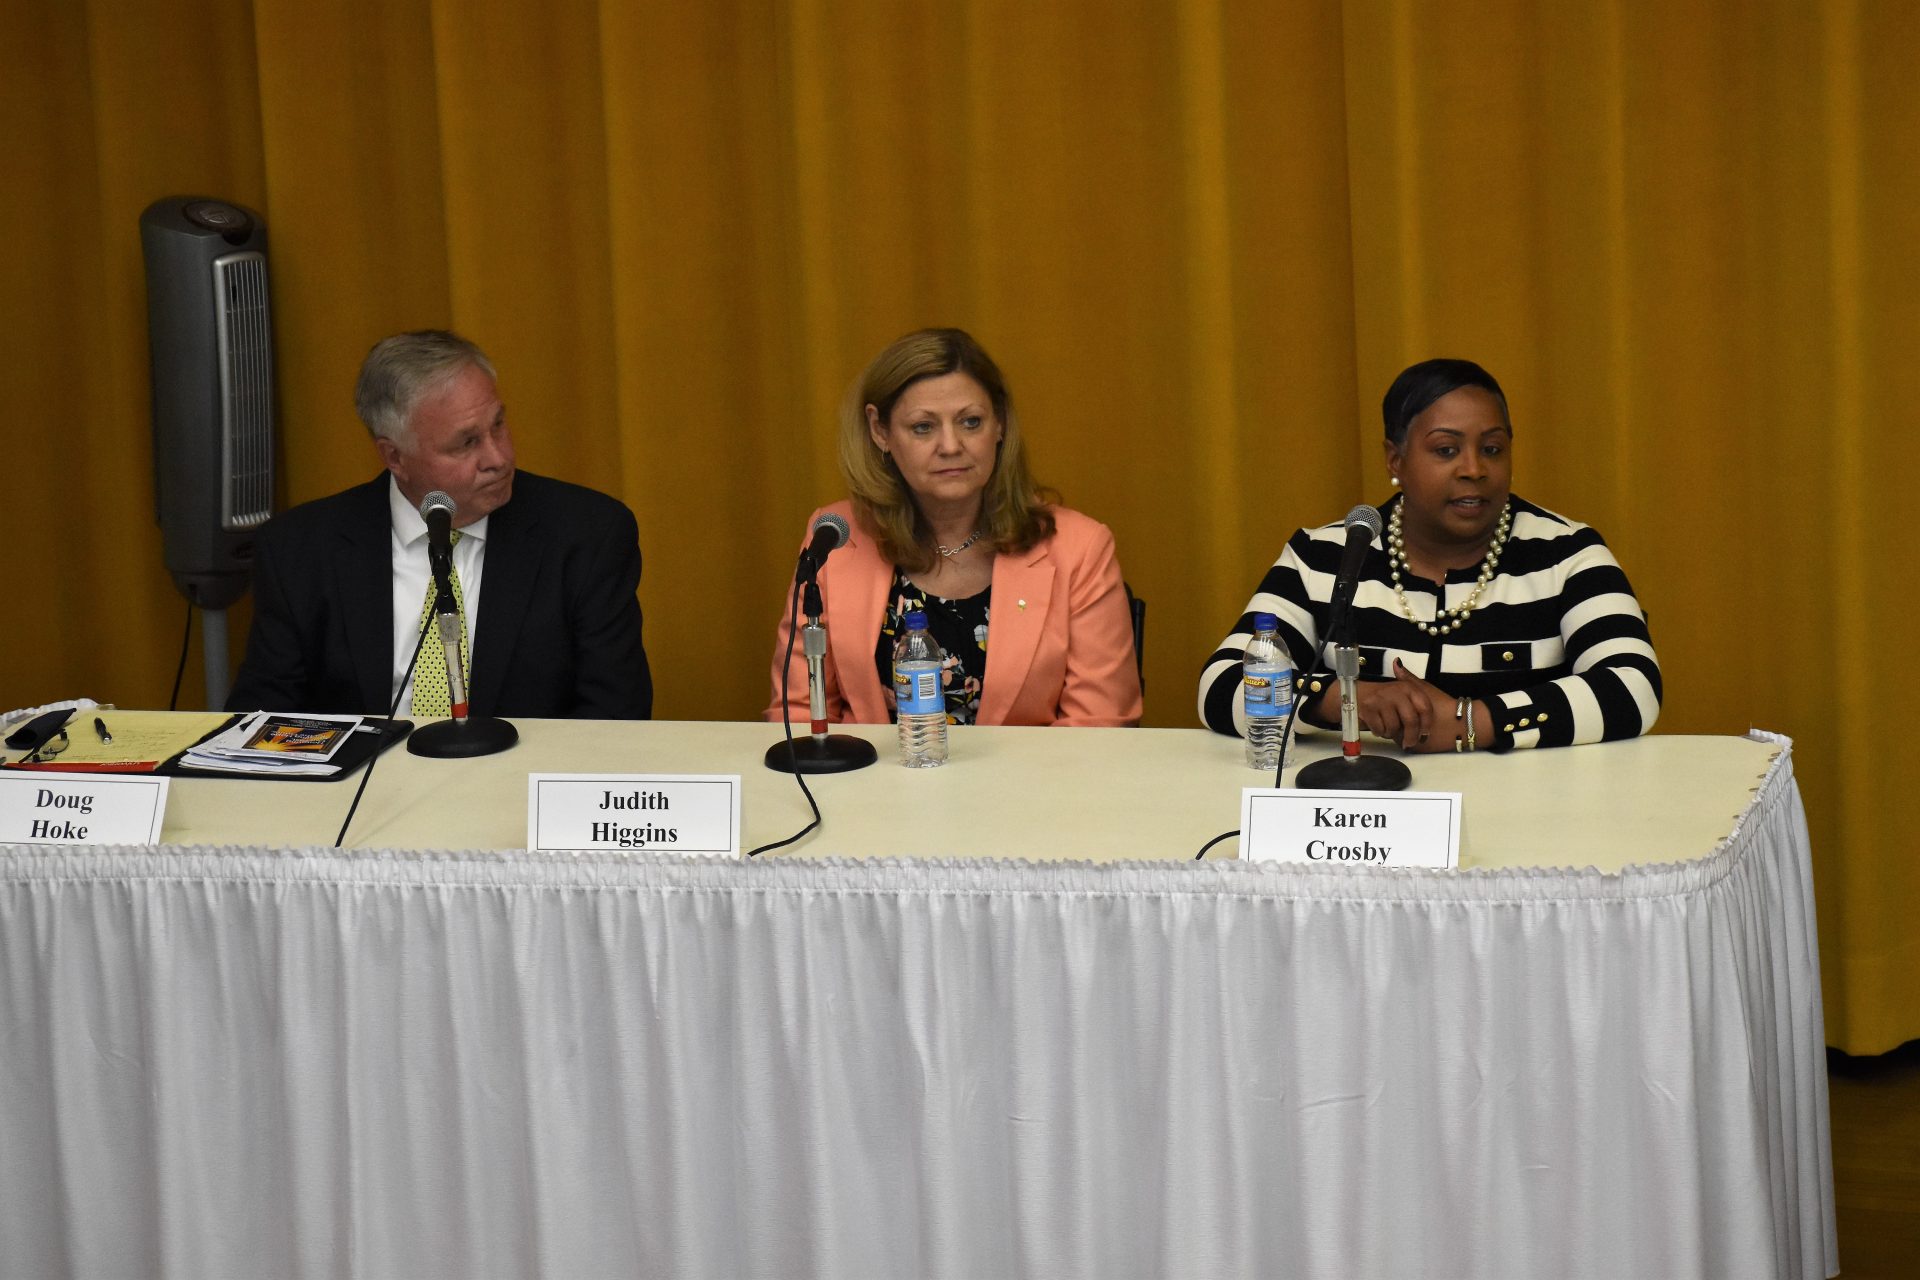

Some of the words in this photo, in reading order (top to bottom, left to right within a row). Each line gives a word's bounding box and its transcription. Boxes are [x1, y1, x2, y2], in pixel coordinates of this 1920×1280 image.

[35, 789, 94, 815] Doug
[599, 790, 669, 810] Judith
[1314, 807, 1387, 828] Karen
[30, 819, 88, 840] Hoke
[591, 822, 678, 848] Higgins
[1305, 840, 1391, 864] Crosby
